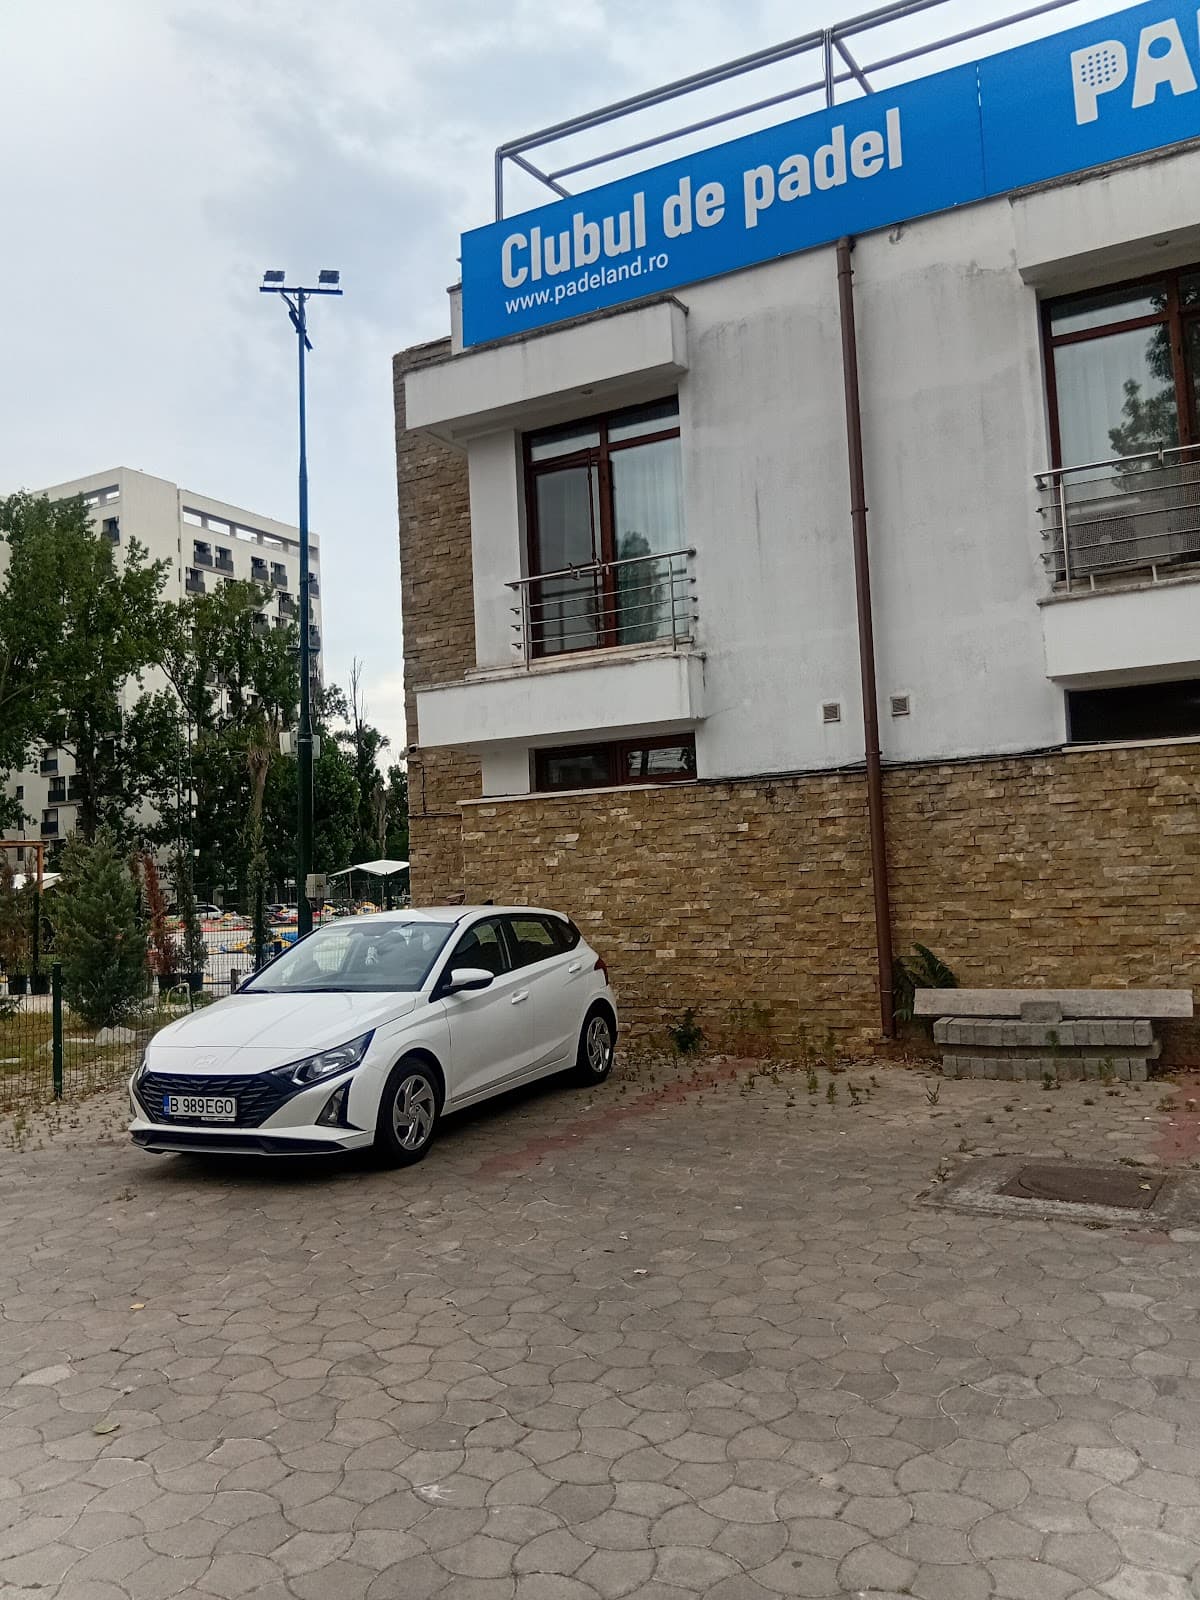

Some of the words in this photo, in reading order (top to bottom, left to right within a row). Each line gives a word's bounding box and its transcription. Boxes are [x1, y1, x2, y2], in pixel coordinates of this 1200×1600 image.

[1070, 8, 1200, 125] PA
[501, 192, 646, 288] Clubul
[662, 176, 725, 238] de
[743, 107, 903, 229] padel
[505, 253, 669, 314] www.padeland.ro
[170, 1098, 179, 1113] B
[183, 1098, 233, 1114] 989EGO
